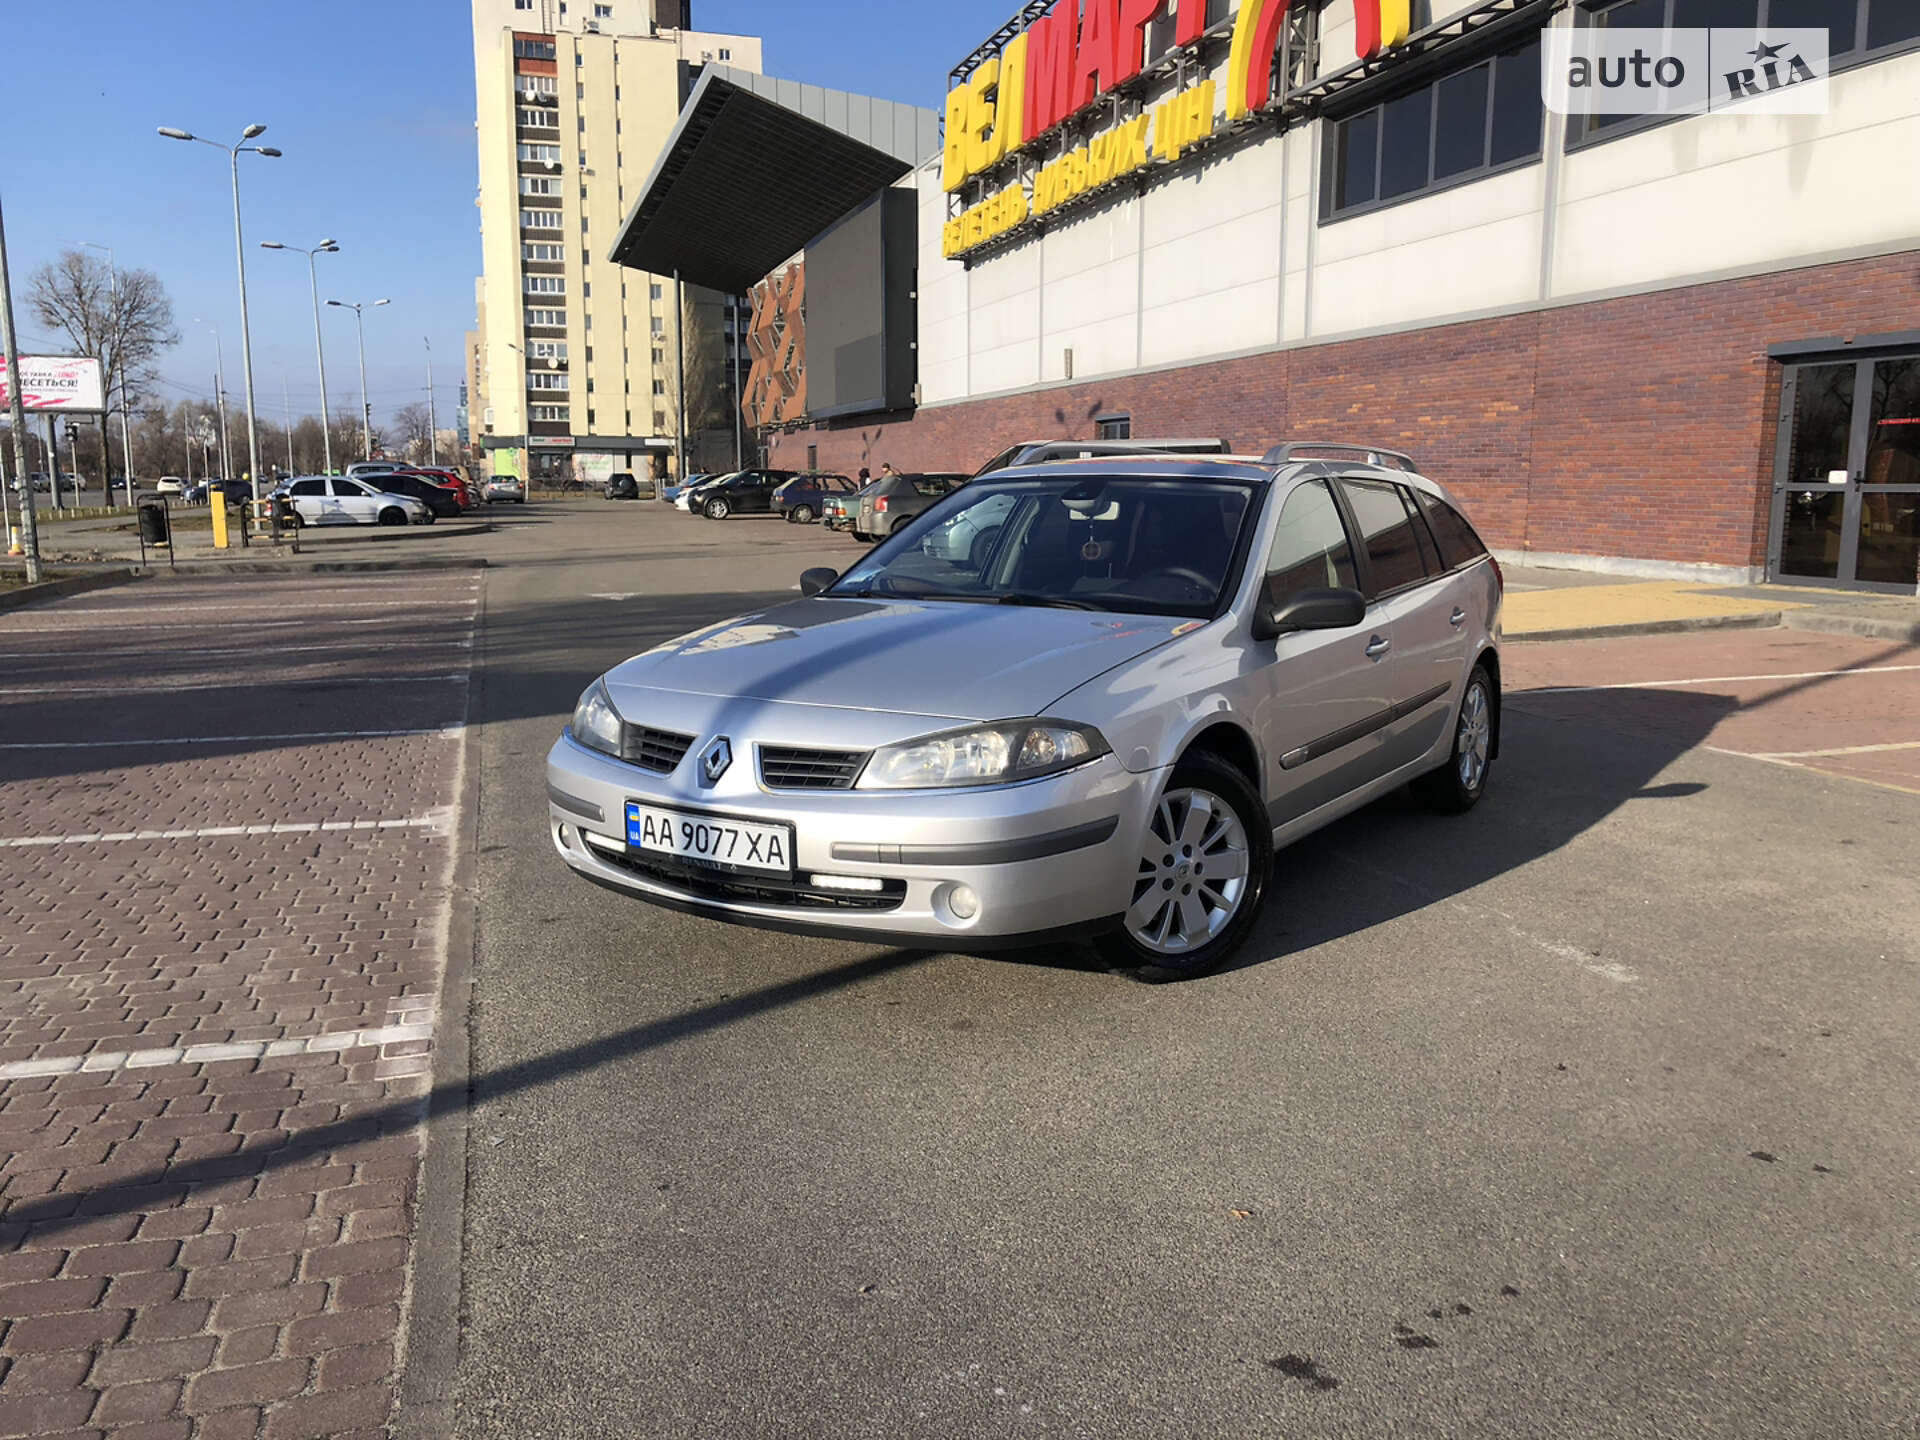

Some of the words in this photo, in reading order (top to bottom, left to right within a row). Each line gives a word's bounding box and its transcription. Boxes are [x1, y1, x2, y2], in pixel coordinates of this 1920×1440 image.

[944, 0, 1207, 192] ВЕЛМАР
[643, 815, 674, 848] AA
[681, 821, 739, 858] 9077
[745, 830, 785, 865] XA
